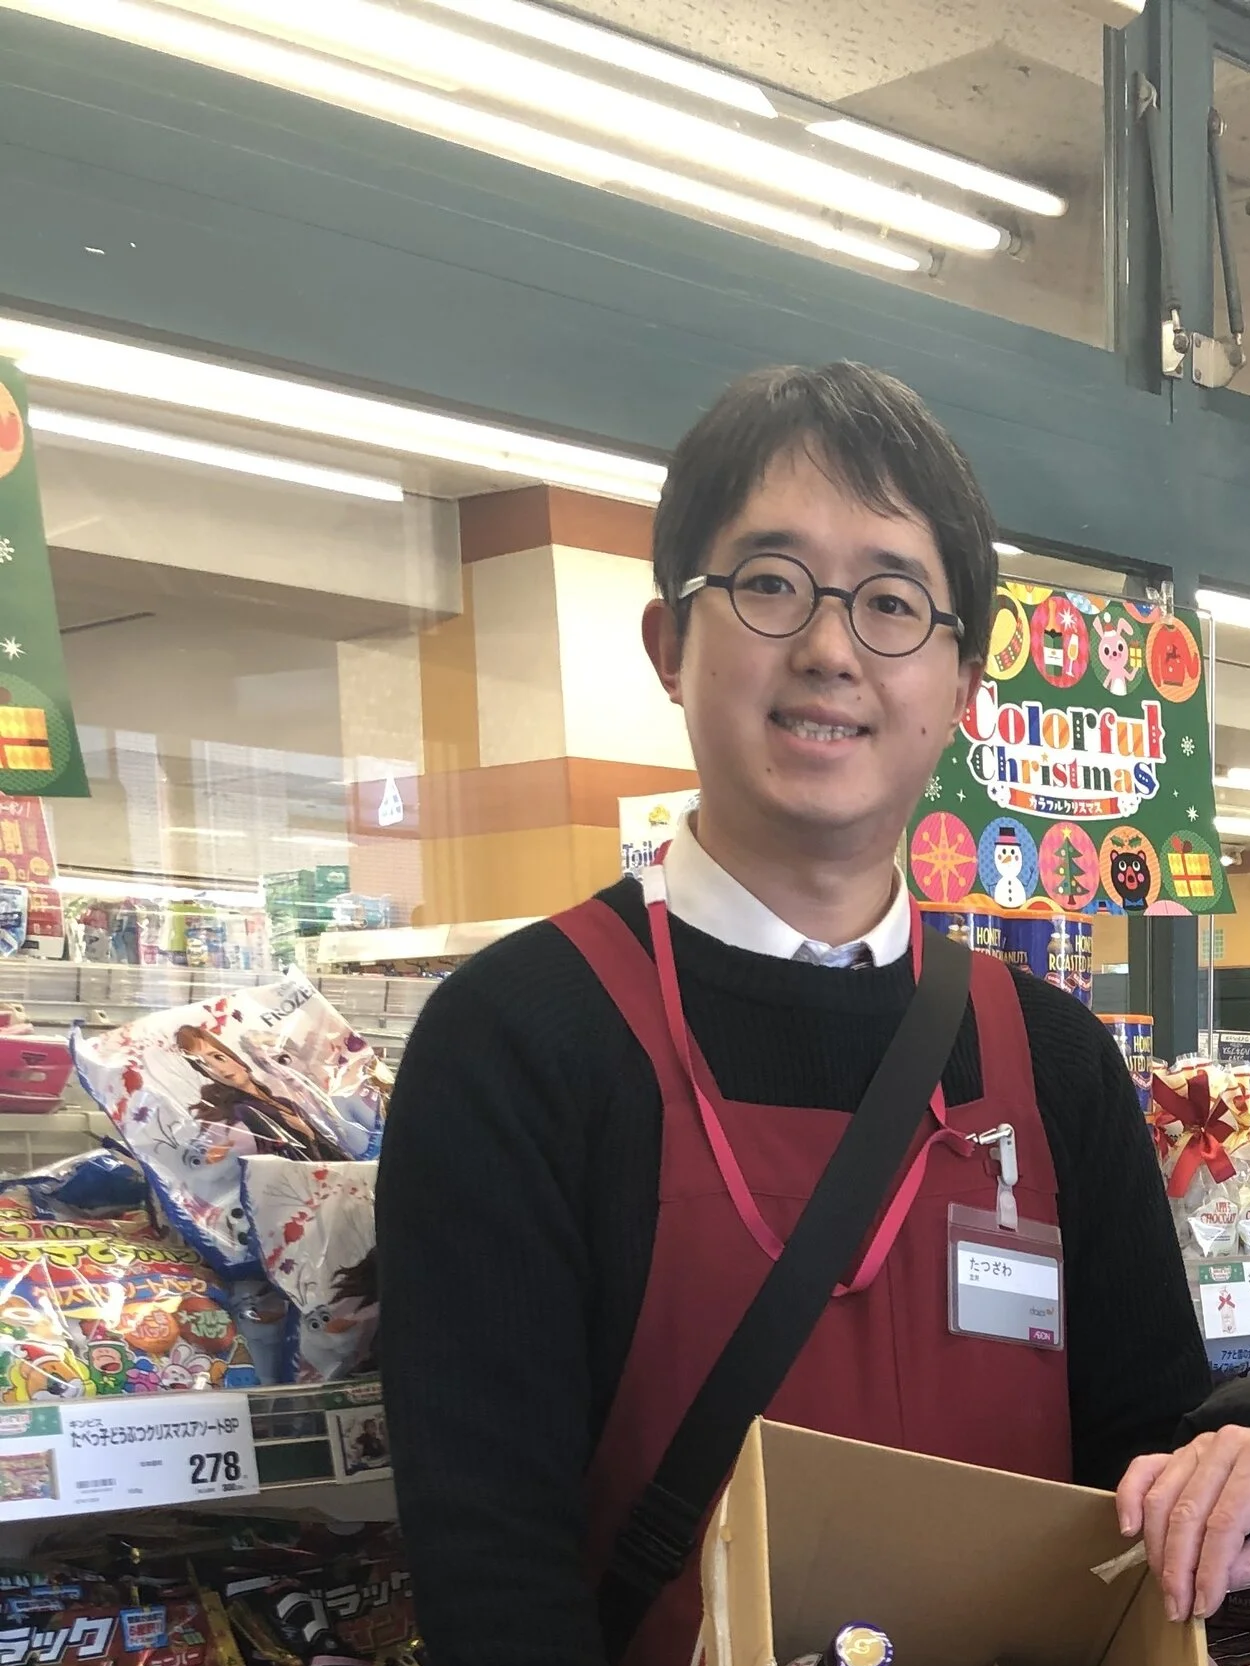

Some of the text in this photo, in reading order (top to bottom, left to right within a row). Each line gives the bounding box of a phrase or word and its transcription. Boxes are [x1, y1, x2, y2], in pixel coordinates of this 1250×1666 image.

[960, 684, 1163, 759] Colorful
[970, 743, 1157, 796] Christmas
[1029, 796, 1103, 814] カラフルクリスマス
[260, 985, 316, 1028] FROZE
[969, 1257, 1013, 1277] たつざわ
[189, 1450, 241, 1485] 278
